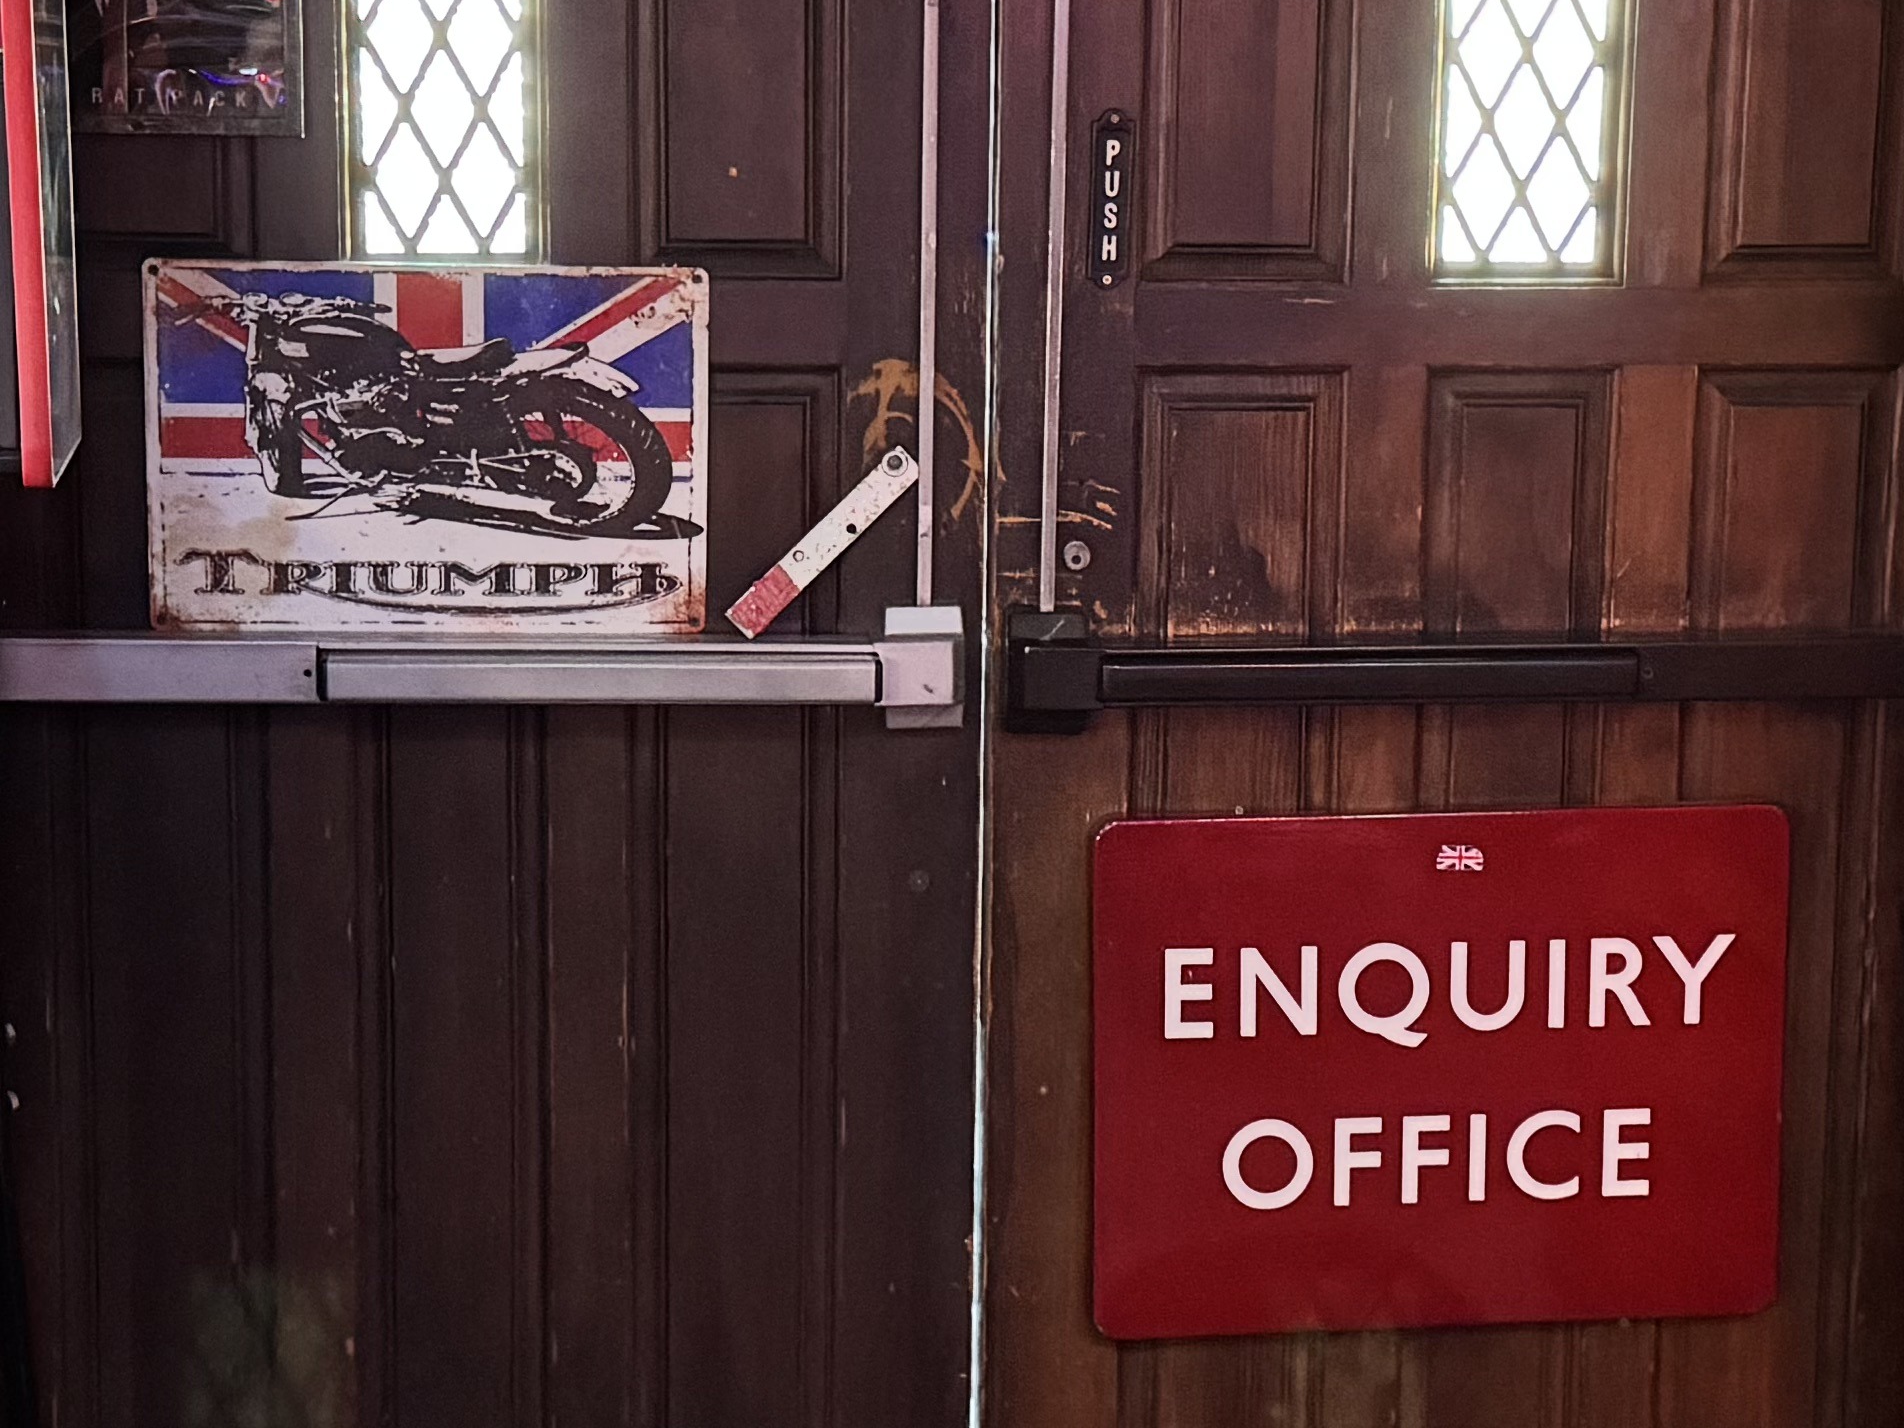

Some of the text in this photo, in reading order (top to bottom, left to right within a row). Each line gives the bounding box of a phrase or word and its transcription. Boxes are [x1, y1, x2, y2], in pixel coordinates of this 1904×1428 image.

[91, 87, 145, 104] RAT
[1101, 135, 1119, 265] PUSH
[179, 548, 683, 604] TRIUMPH
[1162, 931, 1737, 1049] ENQUIRY
[1220, 1107, 1654, 1210] OFFICE
